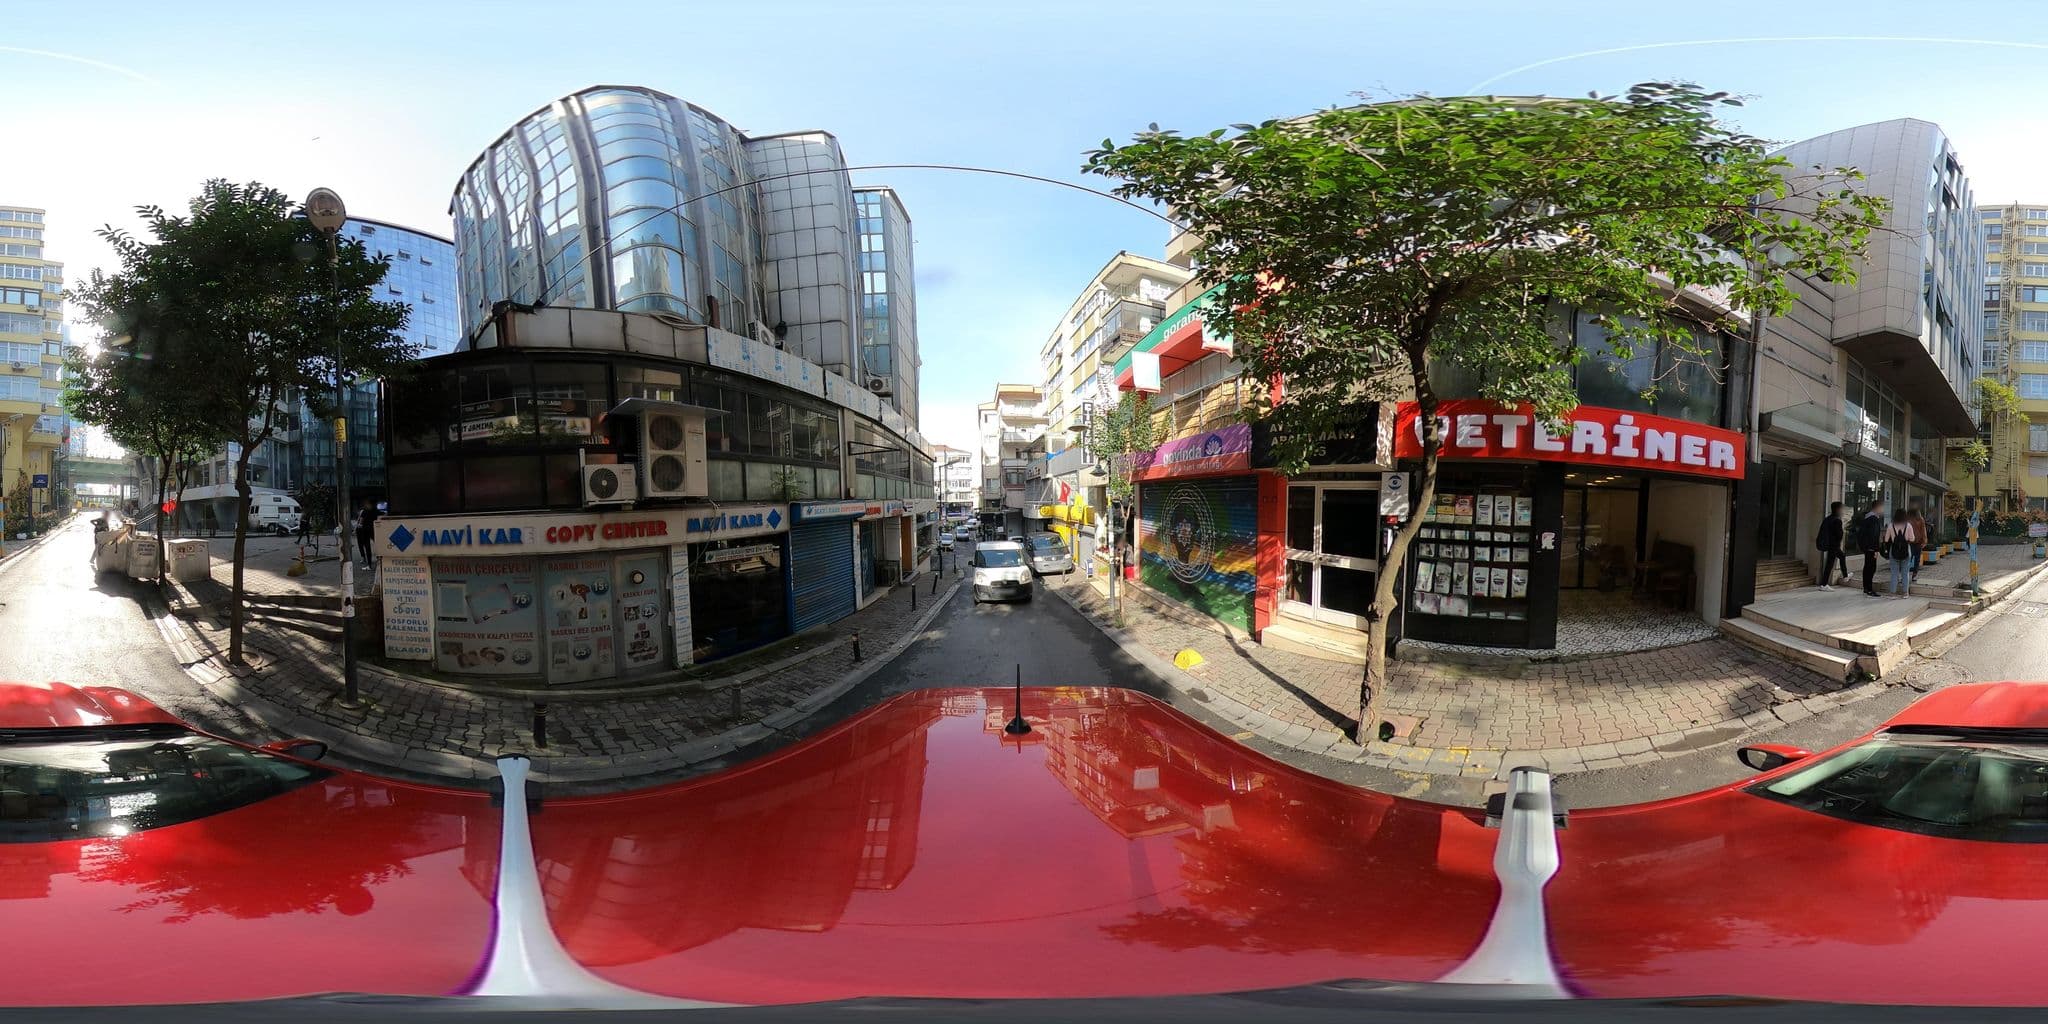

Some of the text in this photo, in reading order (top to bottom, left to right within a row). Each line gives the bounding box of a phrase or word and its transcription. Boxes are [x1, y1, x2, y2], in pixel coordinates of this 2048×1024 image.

[1163, 444, 1202, 466] govinda
[422, 525, 473, 545] MAVİ
[546, 525, 597, 544] COPY
[602, 520, 668, 539] CENTER
[687, 512, 763, 533] MAVİ KARE
[386, 618, 428, 626] FOSFORLU
